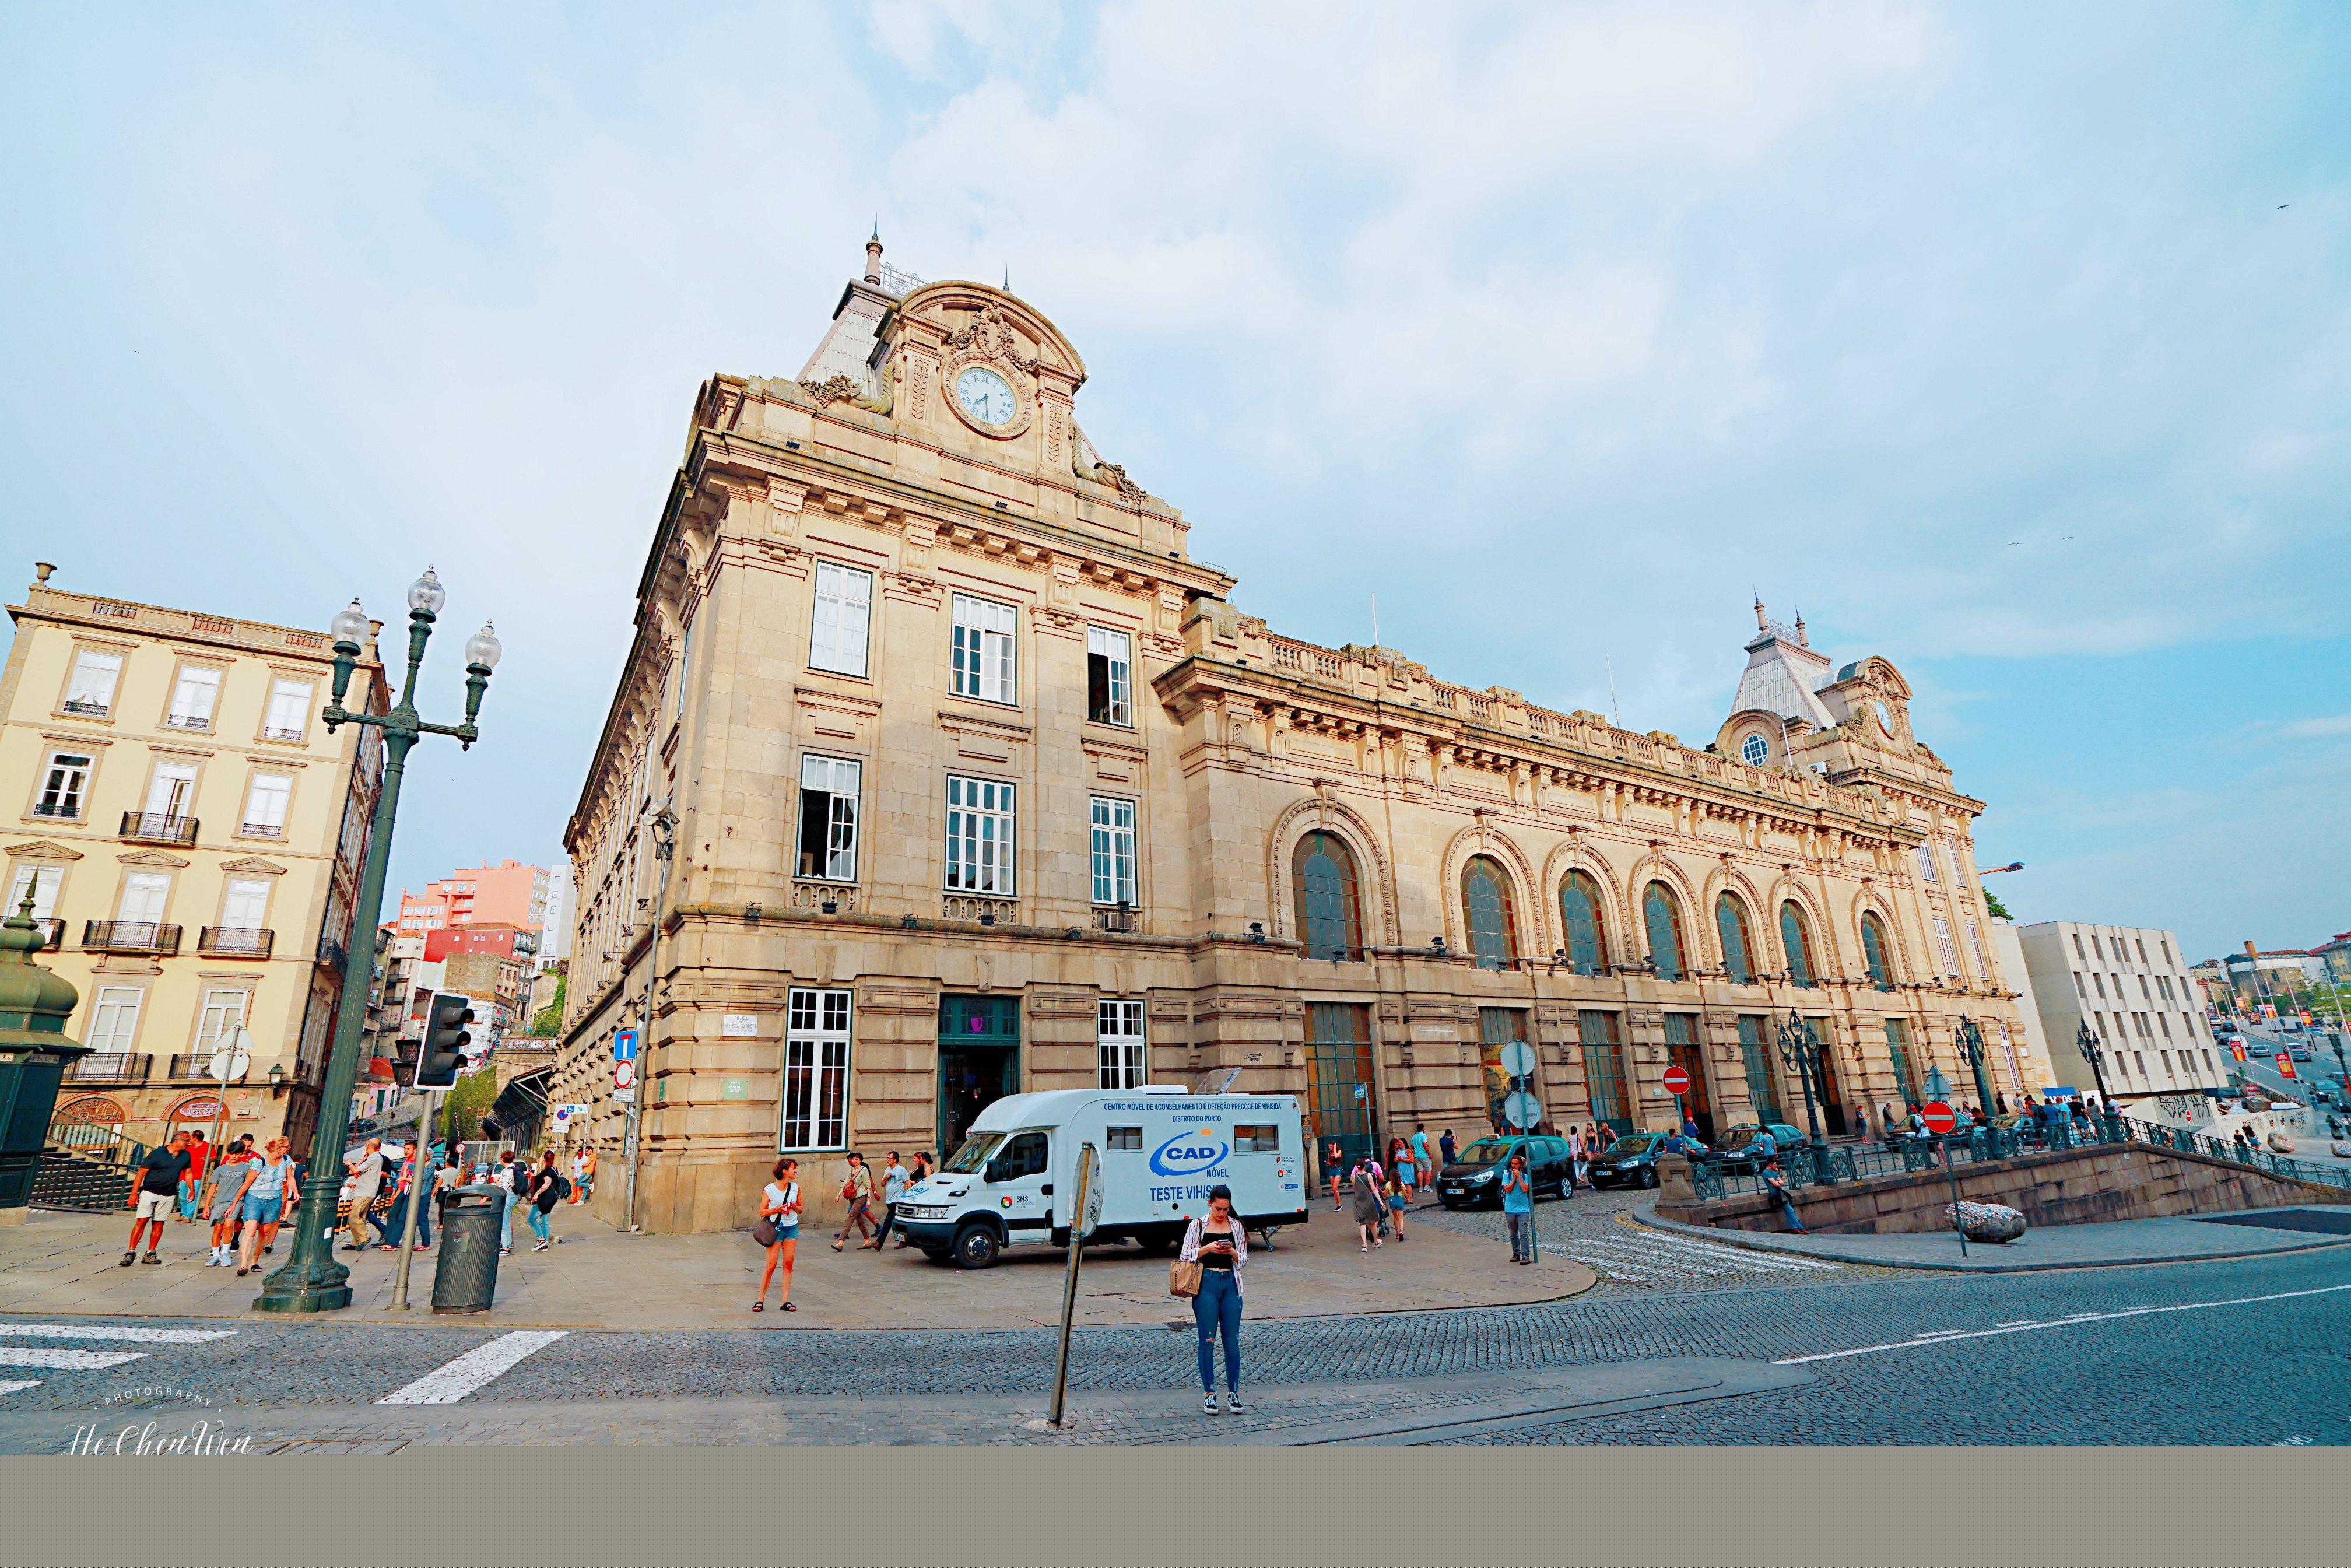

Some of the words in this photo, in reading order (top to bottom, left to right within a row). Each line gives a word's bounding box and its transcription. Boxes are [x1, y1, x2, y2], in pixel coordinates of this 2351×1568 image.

[1127, 1102, 1146, 1110] MÓVEL
[1208, 1102, 1230, 1111] DETEÇÃO
[76, 1110, 122, 1122] Brasil
[1166, 1147, 1215, 1160] CAD
[1206, 1167, 1229, 1177] MÓVEL
[1150, 1186, 1183, 1201] TESTE
[1186, 1184, 1227, 1201] VIH/S
